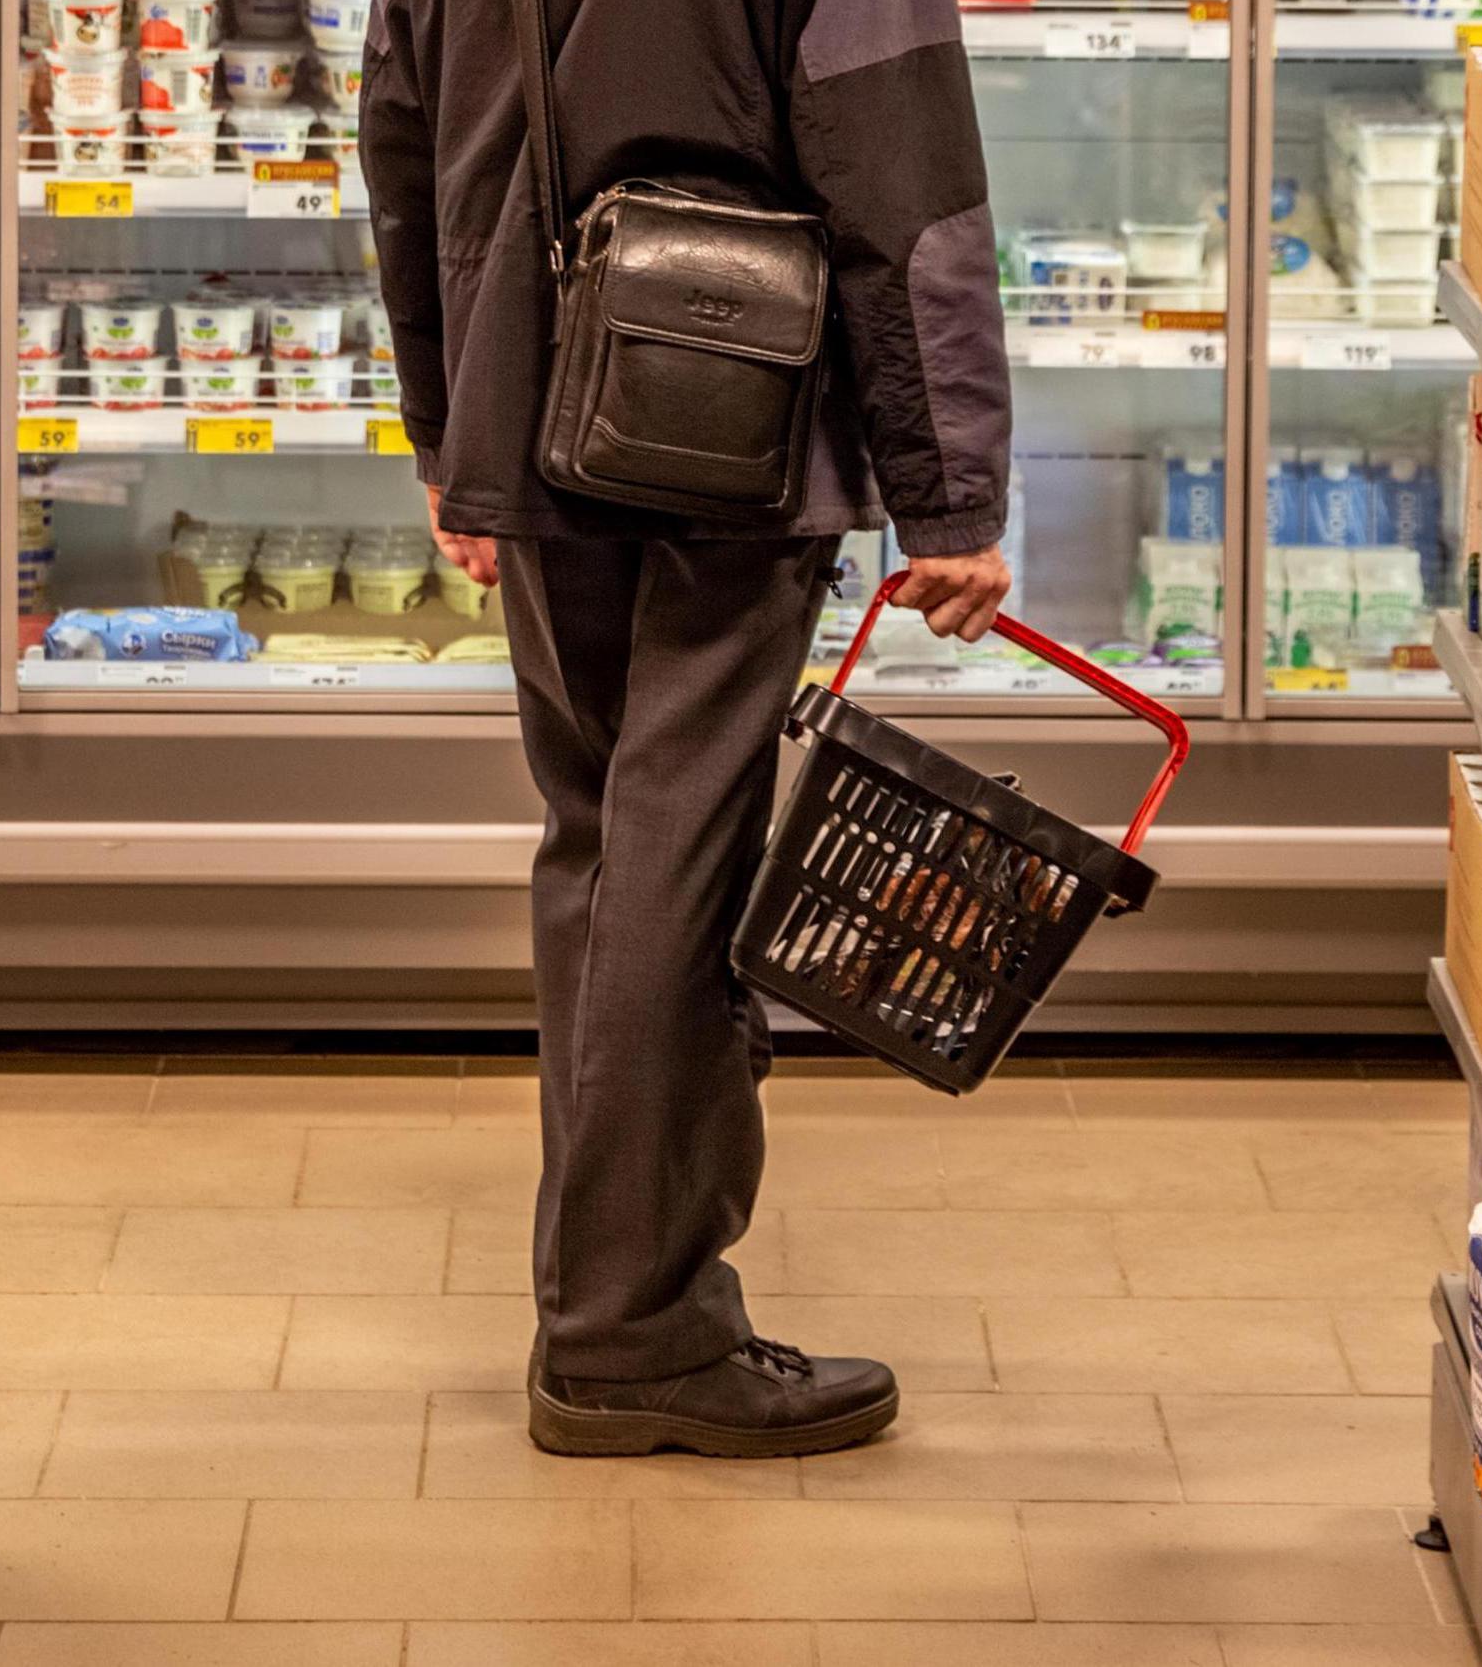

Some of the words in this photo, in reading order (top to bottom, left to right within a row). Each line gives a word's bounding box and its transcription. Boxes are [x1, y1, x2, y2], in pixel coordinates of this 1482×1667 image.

[95, 195, 119, 210] 54
[295, 195, 322, 211] 49
[683, 291, 744, 322] Jeep
[39, 431, 65, 448] 59
[235, 432, 261, 448] 59
